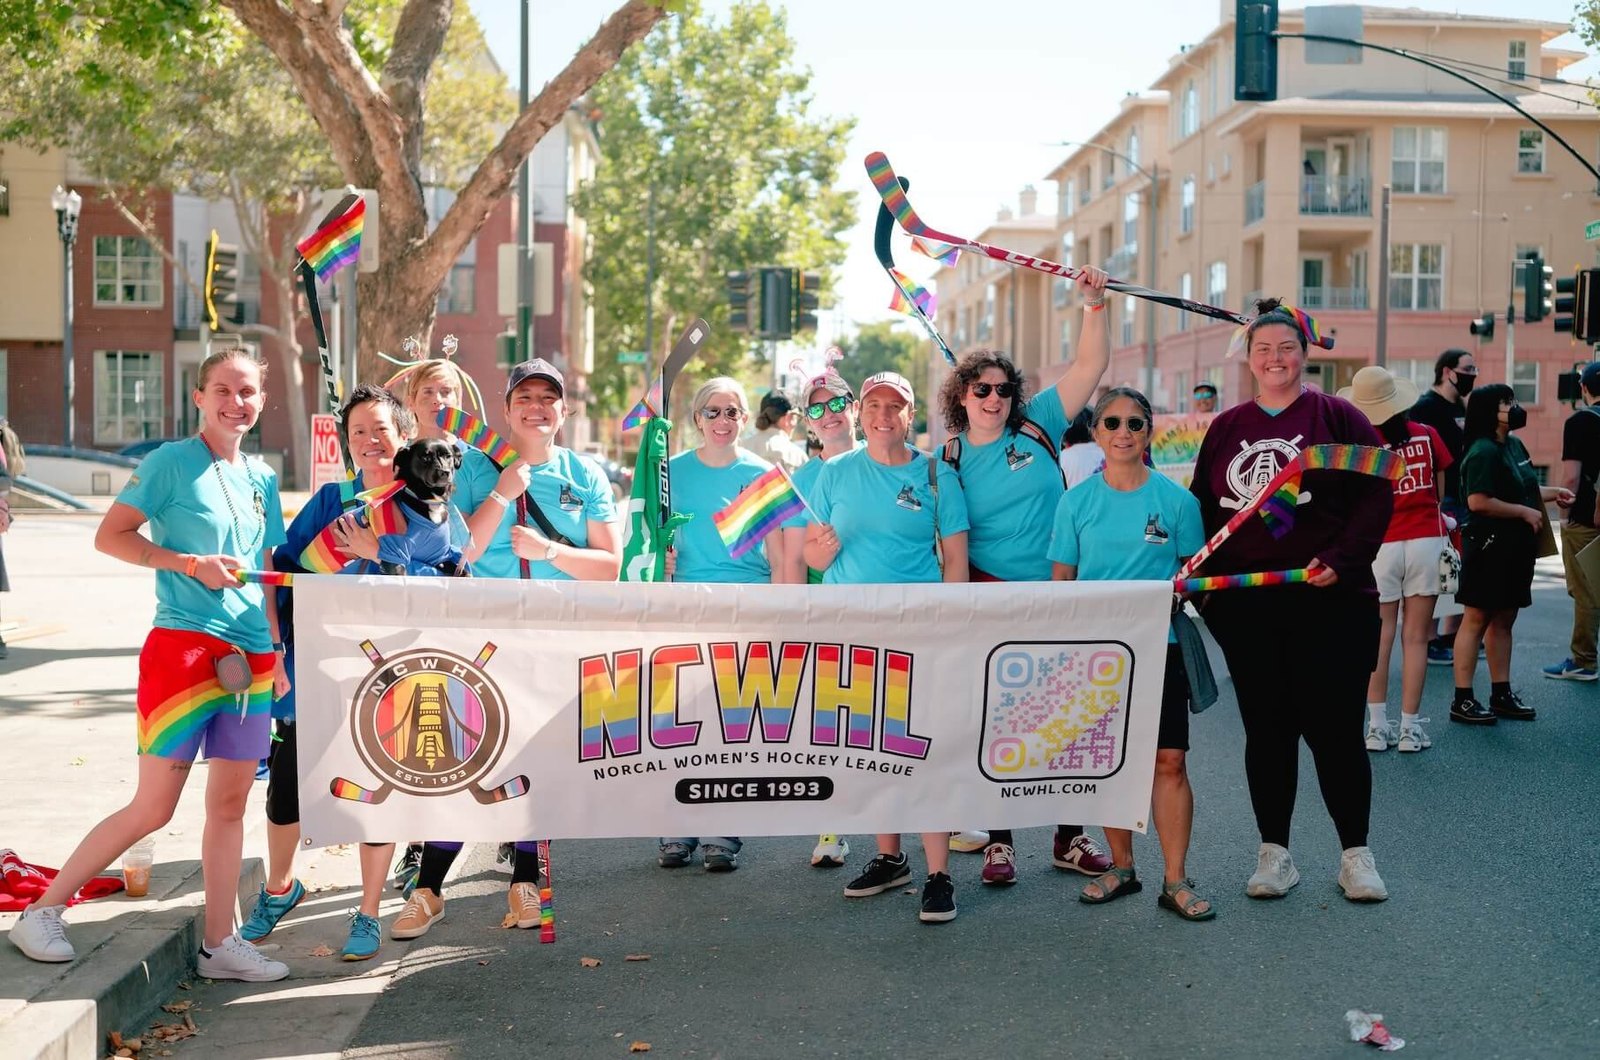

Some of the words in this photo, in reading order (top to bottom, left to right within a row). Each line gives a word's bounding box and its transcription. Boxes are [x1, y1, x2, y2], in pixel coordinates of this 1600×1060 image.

[1005, 251, 1083, 279] CCM
[318, 346, 343, 424] CCM
[315, 434, 338, 463] NO
[1174, 439, 1200, 455] LOV
[578, 641, 933, 763] NCWHL
[395, 769, 424, 785] EST.
[432, 769, 467, 785] 1993
[594, 759, 667, 780] NORCAL
[674, 751, 760, 769] WOMEN'S
[767, 751, 839, 767] HOCKEY
[845, 757, 914, 777] LEAGUE
[689, 783, 758, 800] SINCE
[767, 781, 820, 797] 1993
[1000, 783, 1097, 798] NCWHL.COM
